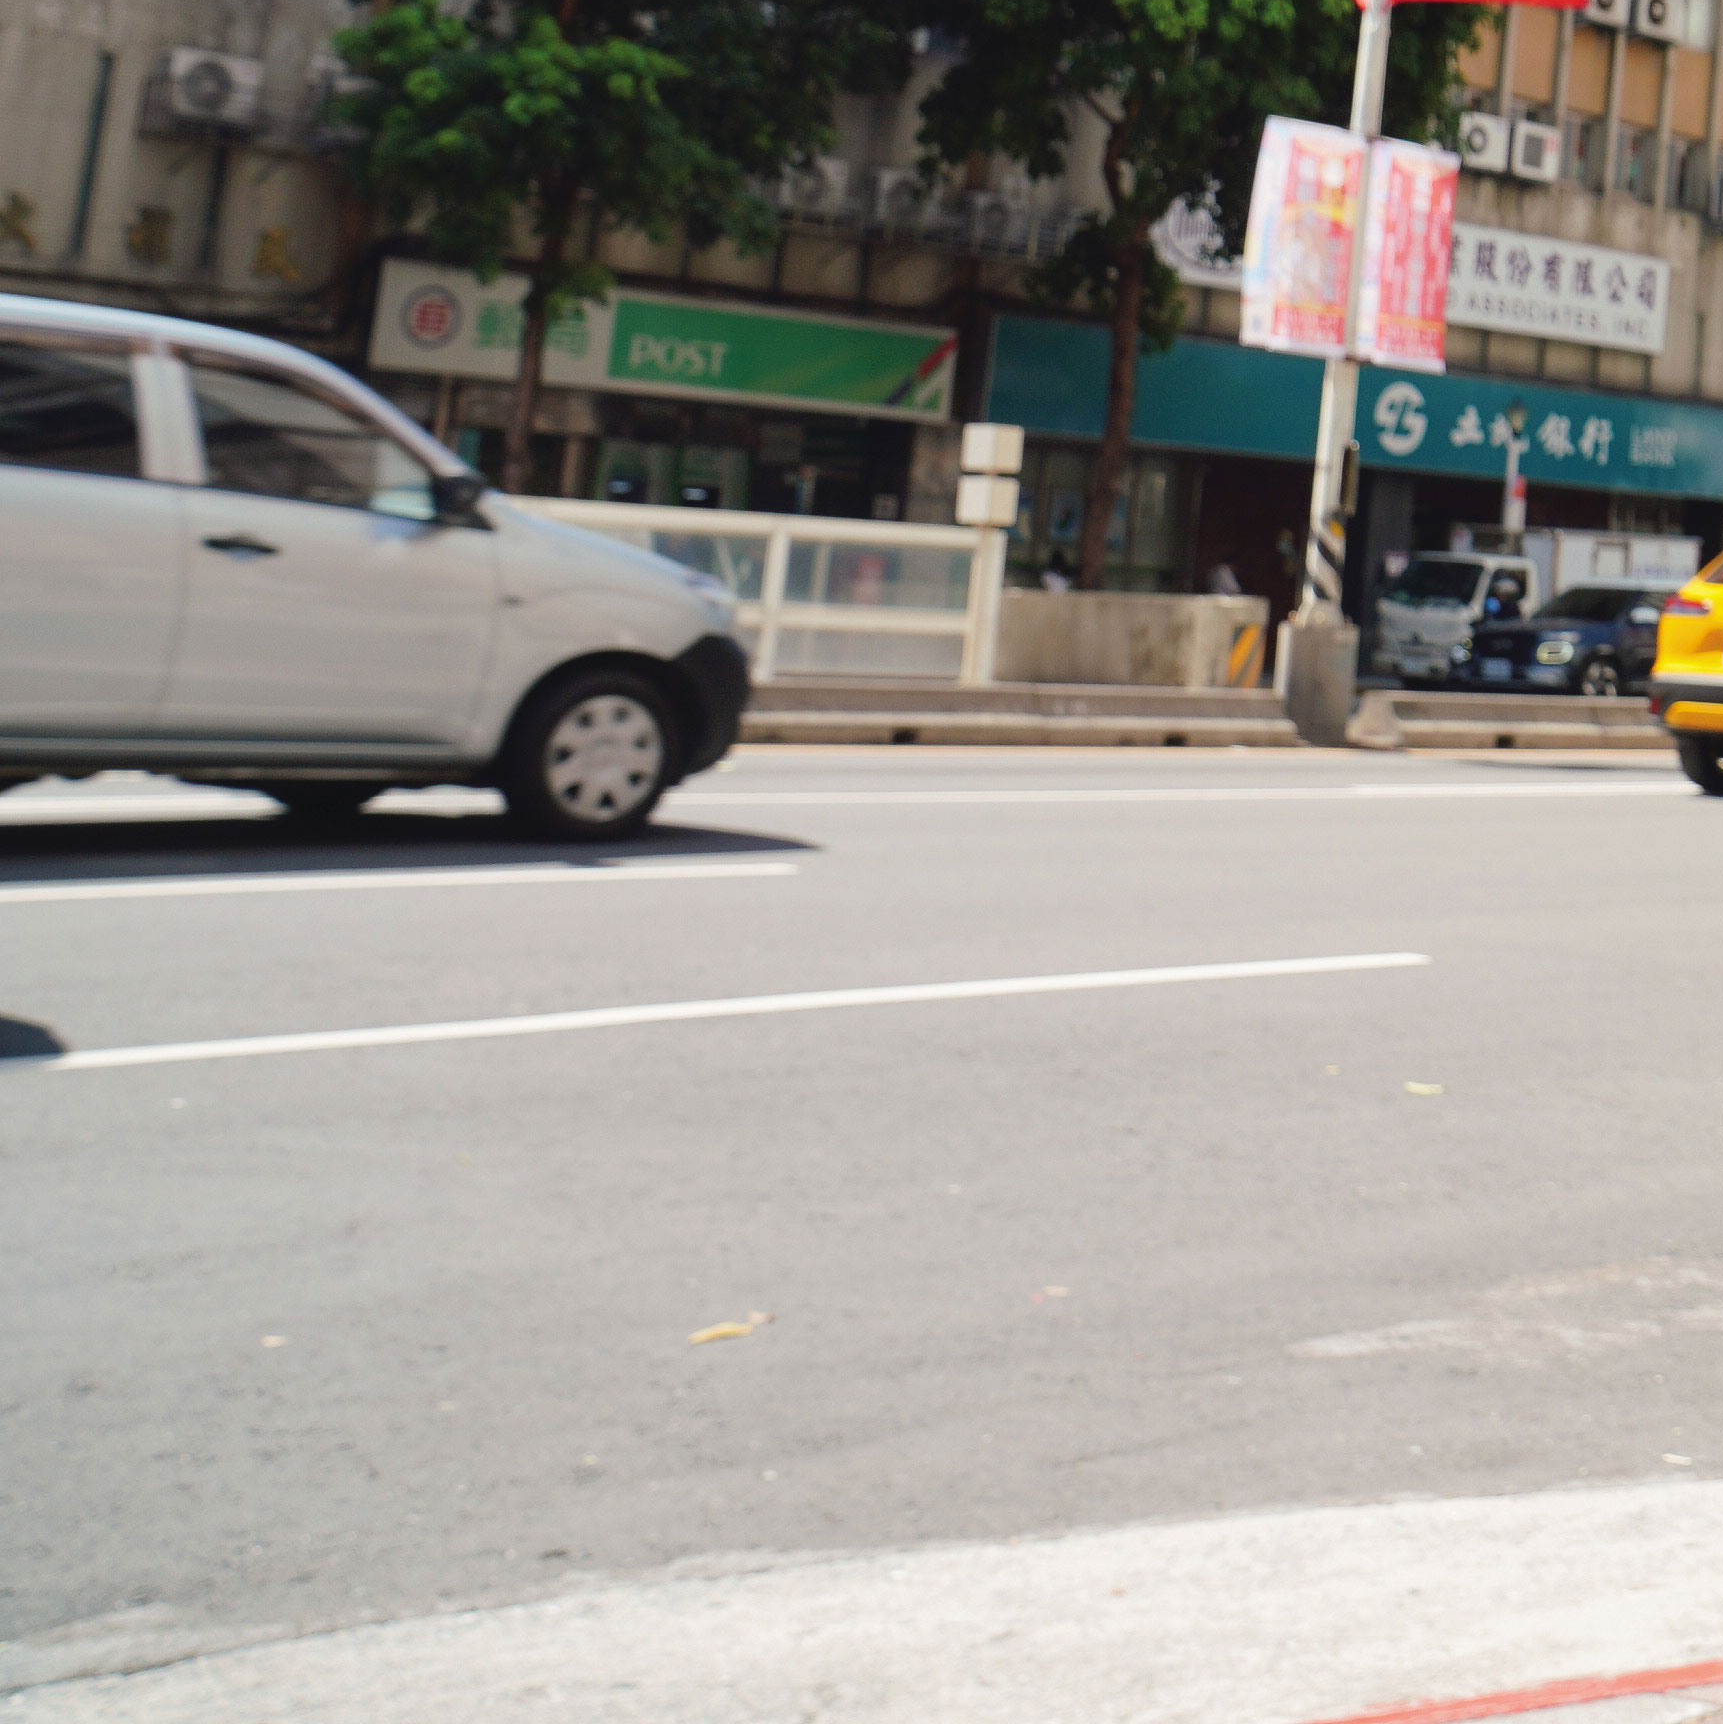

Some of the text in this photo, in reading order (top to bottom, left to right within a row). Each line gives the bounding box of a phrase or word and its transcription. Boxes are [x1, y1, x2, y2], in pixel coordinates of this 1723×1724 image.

[628, 332, 727, 377] POST
[1449, 404, 1614, 467] 土地銀行
